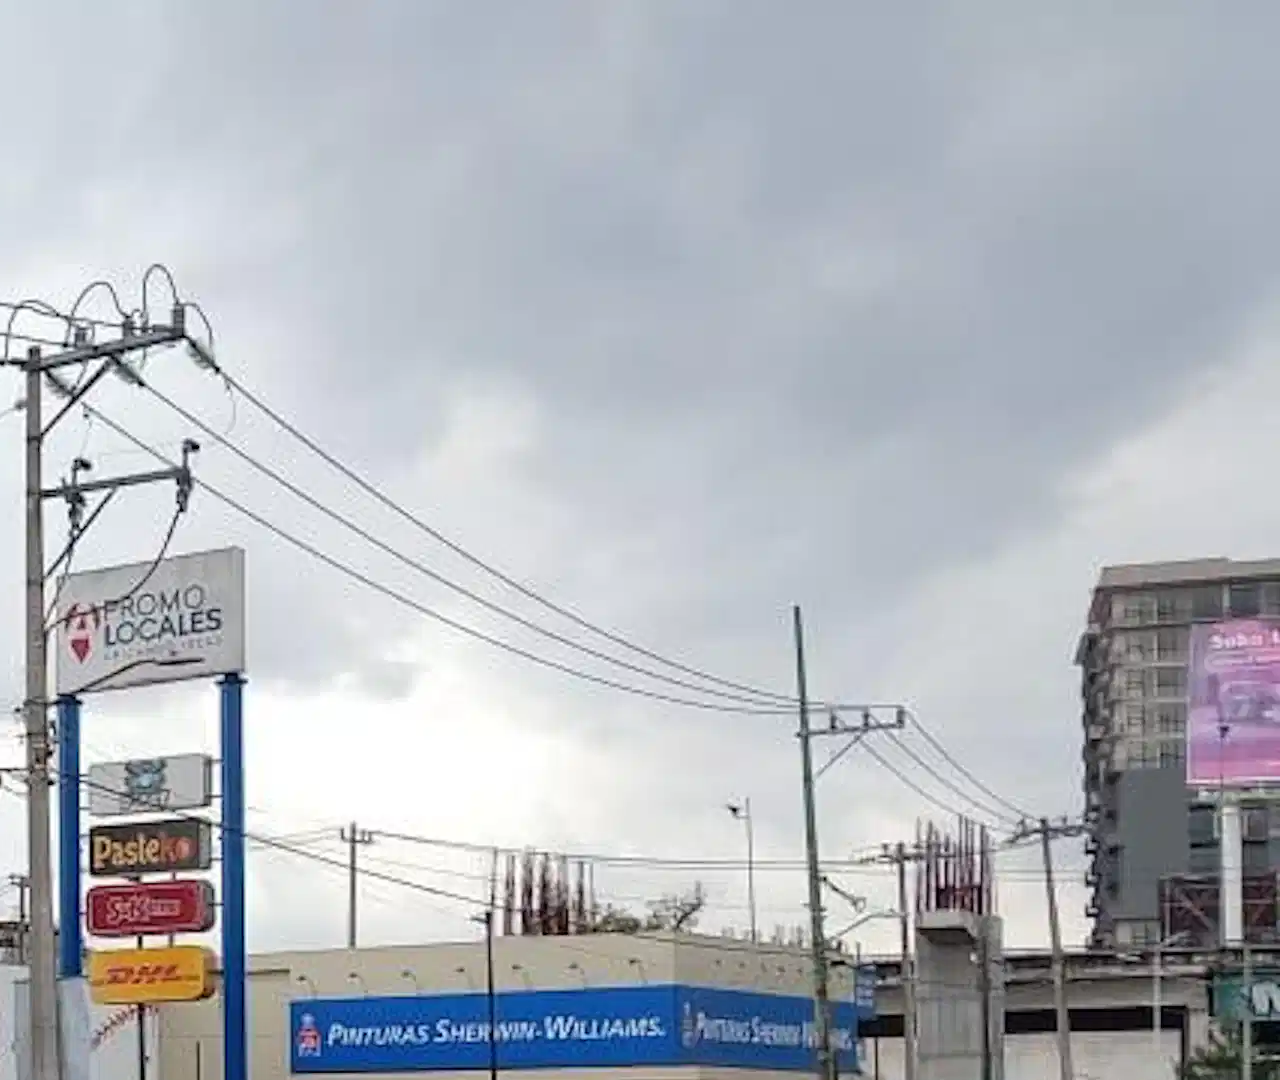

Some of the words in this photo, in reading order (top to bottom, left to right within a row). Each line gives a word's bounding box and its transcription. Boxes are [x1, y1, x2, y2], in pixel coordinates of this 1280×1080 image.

[104, 608, 222, 647] LOCALES
[105, 962, 182, 985] DHL
[326, 1023, 430, 1047] PINTURAS
